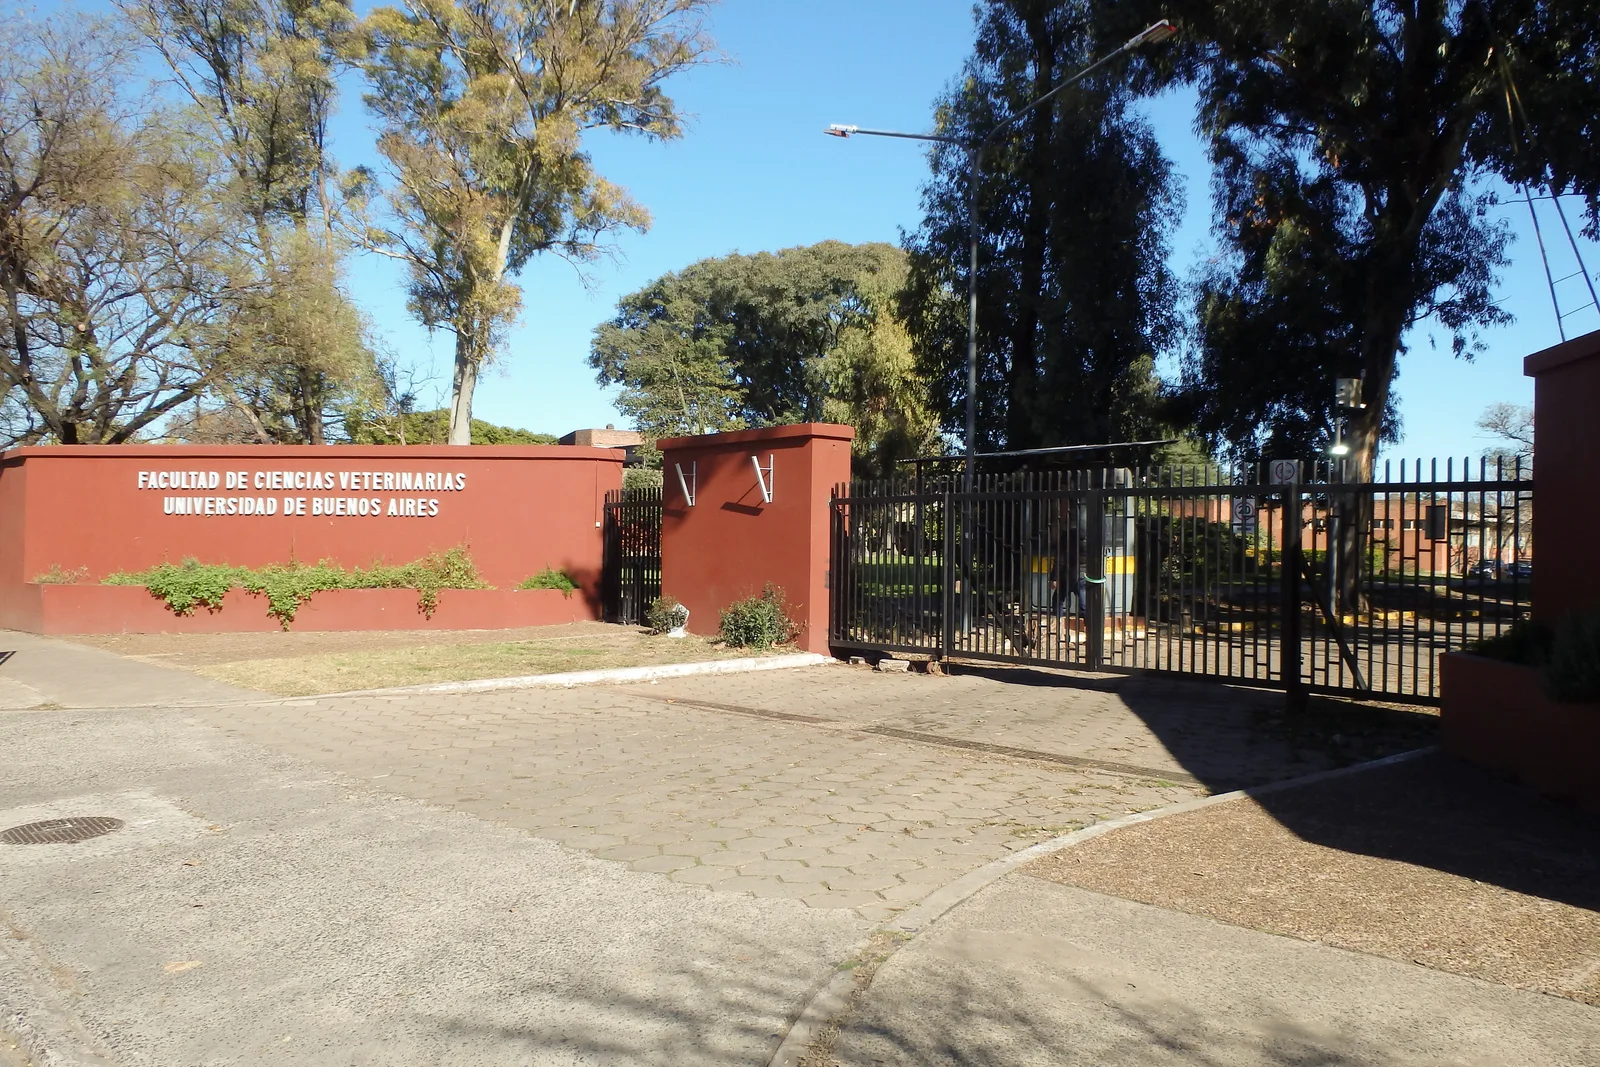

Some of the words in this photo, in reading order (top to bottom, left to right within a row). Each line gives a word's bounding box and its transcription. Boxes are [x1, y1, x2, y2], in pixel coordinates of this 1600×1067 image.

[138, 471, 220, 490] FACULTAD
[225, 471, 248, 490] DE
[254, 471, 335, 490] CIENCIAS
[339, 472, 466, 491] VETERINARIAS
[163, 496, 277, 516] UNIVERSIDAD
[284, 497, 306, 516] DE
[312, 497, 381, 517] BUENOS
[387, 498, 439, 517] AIRES
[1238, 505, 1251, 514] 20
